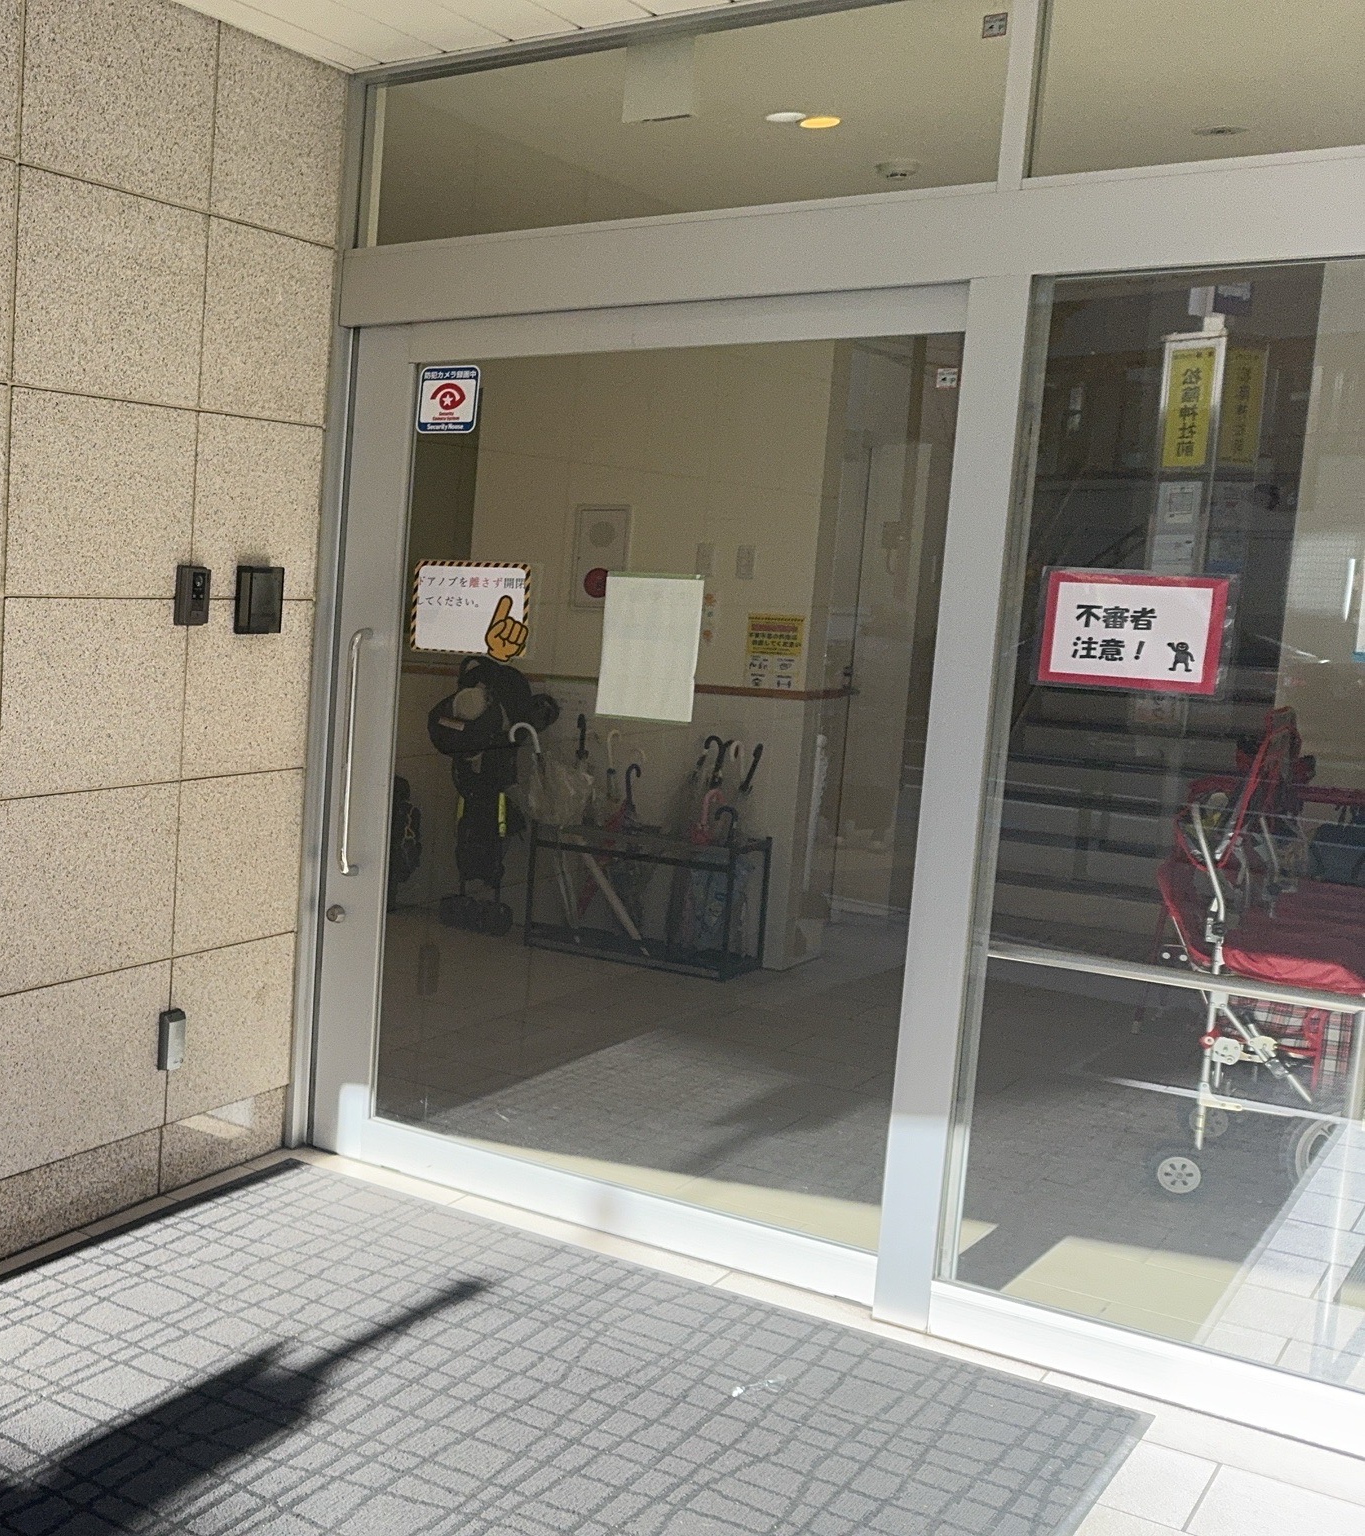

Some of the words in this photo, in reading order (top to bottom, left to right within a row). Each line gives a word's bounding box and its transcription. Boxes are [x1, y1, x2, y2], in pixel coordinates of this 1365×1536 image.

[416, 596, 479, 608] してください。
[1075, 604, 1158, 631] 不審者
[1071, 636, 1145, 662] 注意！
